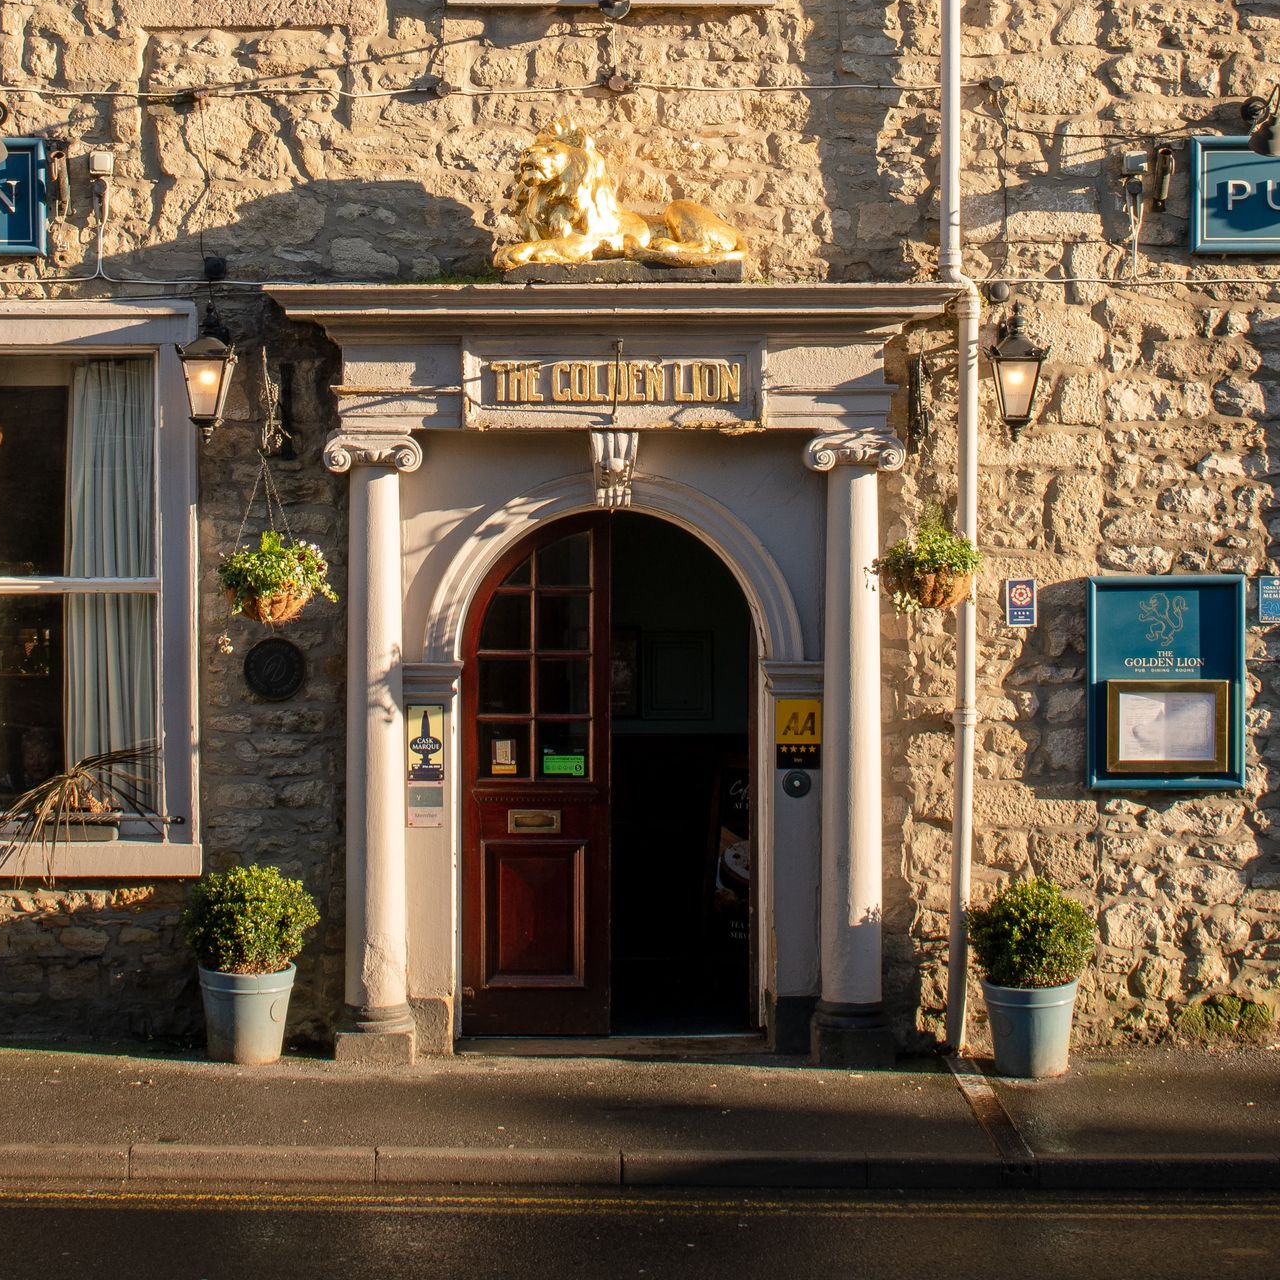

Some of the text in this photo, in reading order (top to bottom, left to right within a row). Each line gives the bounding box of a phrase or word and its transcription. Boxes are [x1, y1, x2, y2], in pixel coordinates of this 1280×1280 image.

[491, 361, 741, 404] THE GOLDEN LION
[1124, 657, 1205, 667] GOLDEN LION
[782, 712, 816, 736] AA
